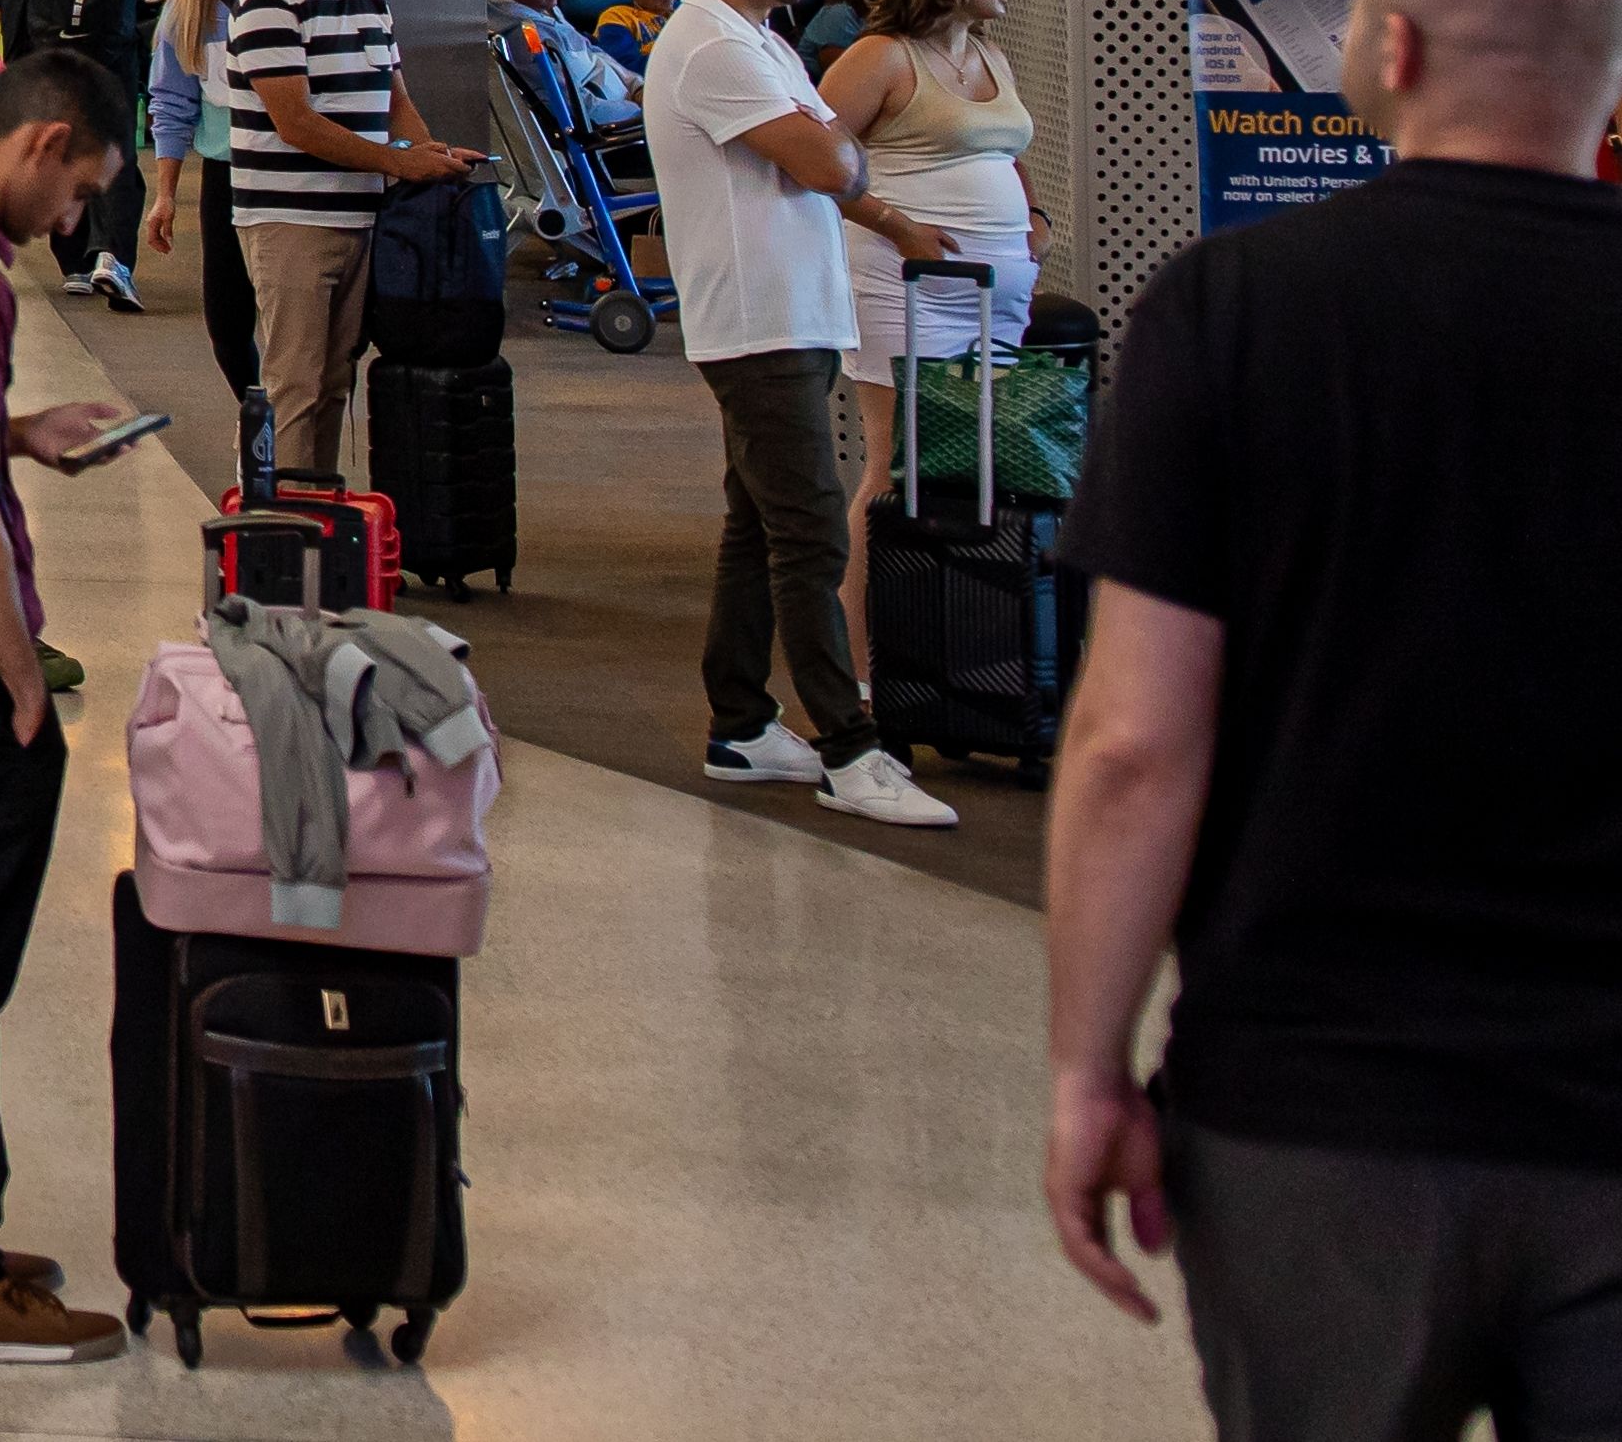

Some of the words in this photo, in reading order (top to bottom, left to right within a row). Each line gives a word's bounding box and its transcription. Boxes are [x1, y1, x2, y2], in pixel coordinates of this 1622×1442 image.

[1209, 109, 1302, 135] Watch
[1258, 143, 1348, 164] movies
[1354, 145, 1373, 164] &
[1378, 145, 1398, 165] T
[1229, 175, 1260, 187] with
[1264, 175, 1318, 188] United's
[1321, 177, 1368, 188] Person
[1223, 191, 1252, 202] now
[1255, 191, 1273, 202] on
[1276, 189, 1314, 203] select
